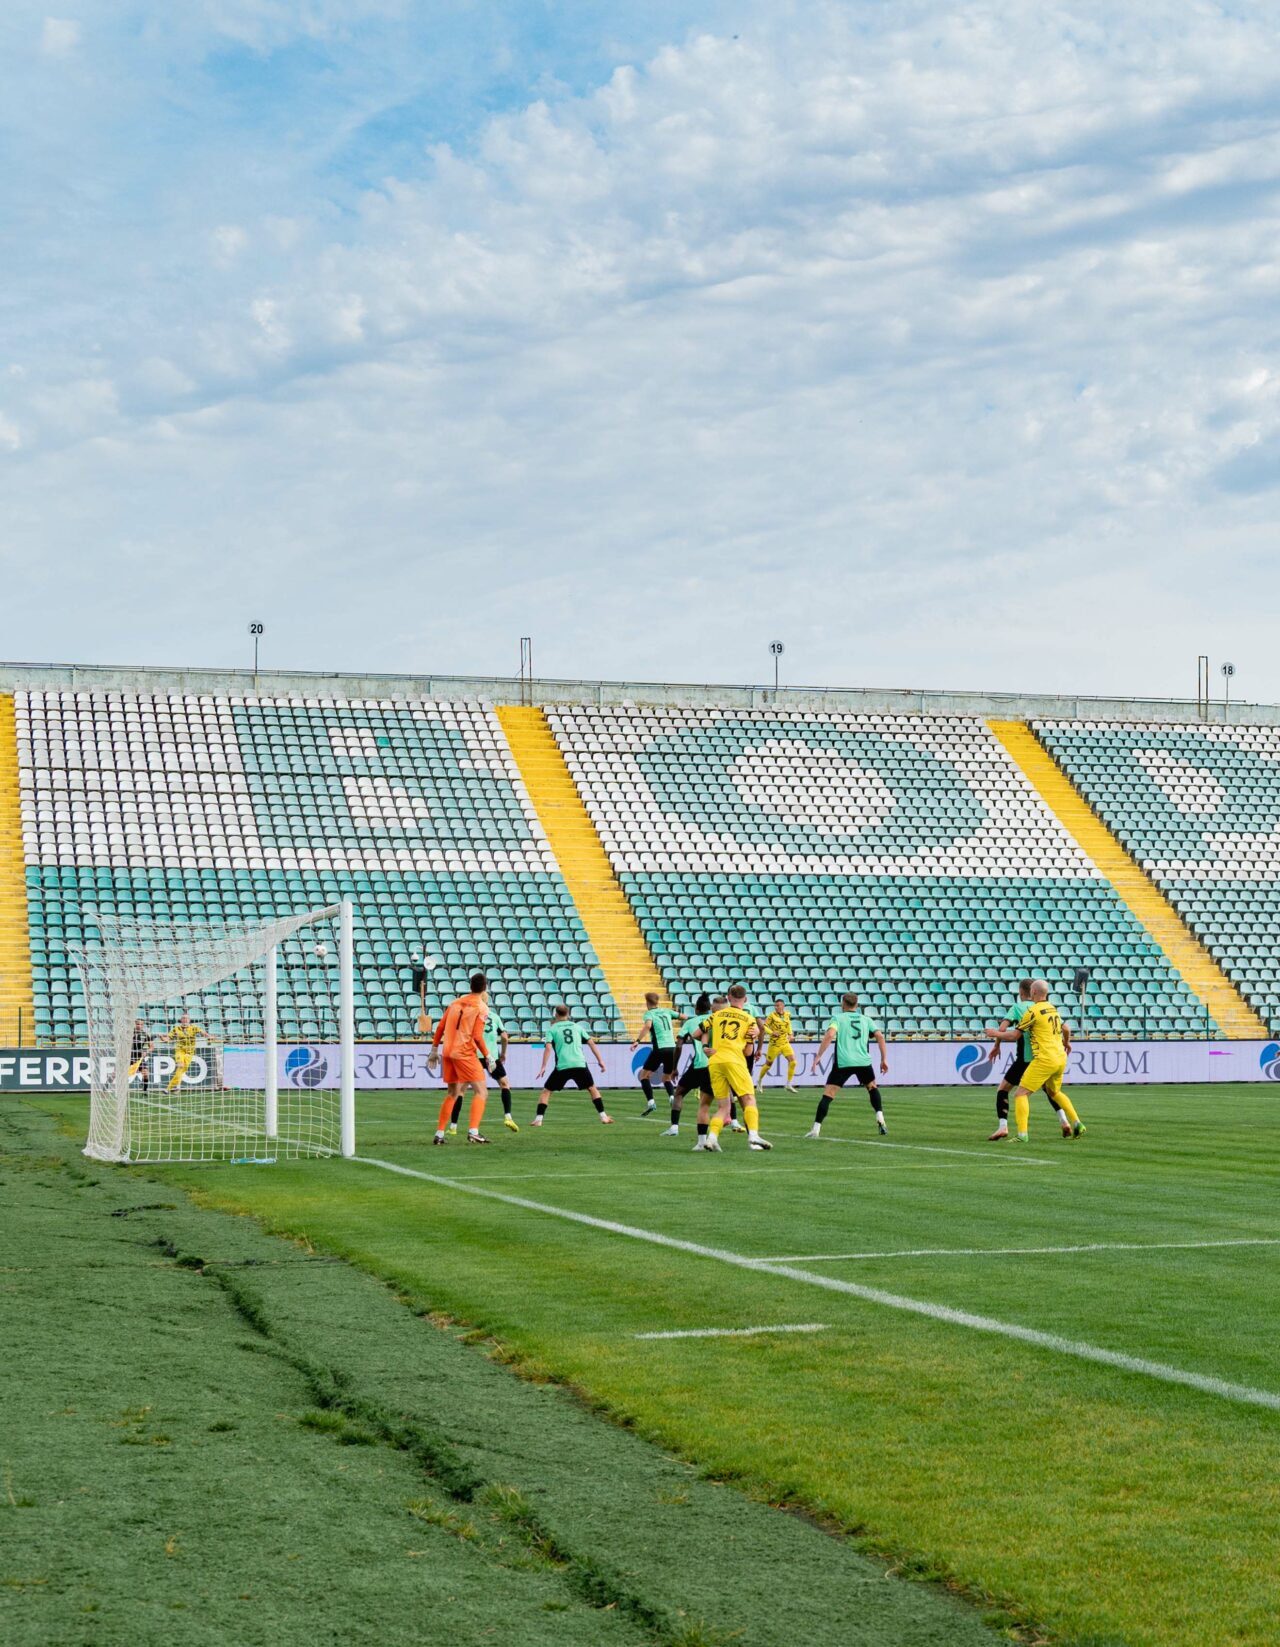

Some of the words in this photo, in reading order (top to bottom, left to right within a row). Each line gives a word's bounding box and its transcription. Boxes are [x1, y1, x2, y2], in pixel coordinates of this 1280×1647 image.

[250, 623, 264, 634] 20
[771, 643, 783, 654] 19
[1222, 665, 1233, 675] 18
[456, 1009, 463, 1030] 1
[657, 1014, 671, 1031] 11
[563, 1028, 574, 1045] 8
[719, 1019, 741, 1041] 13
[850, 1020, 862, 1040] 5
